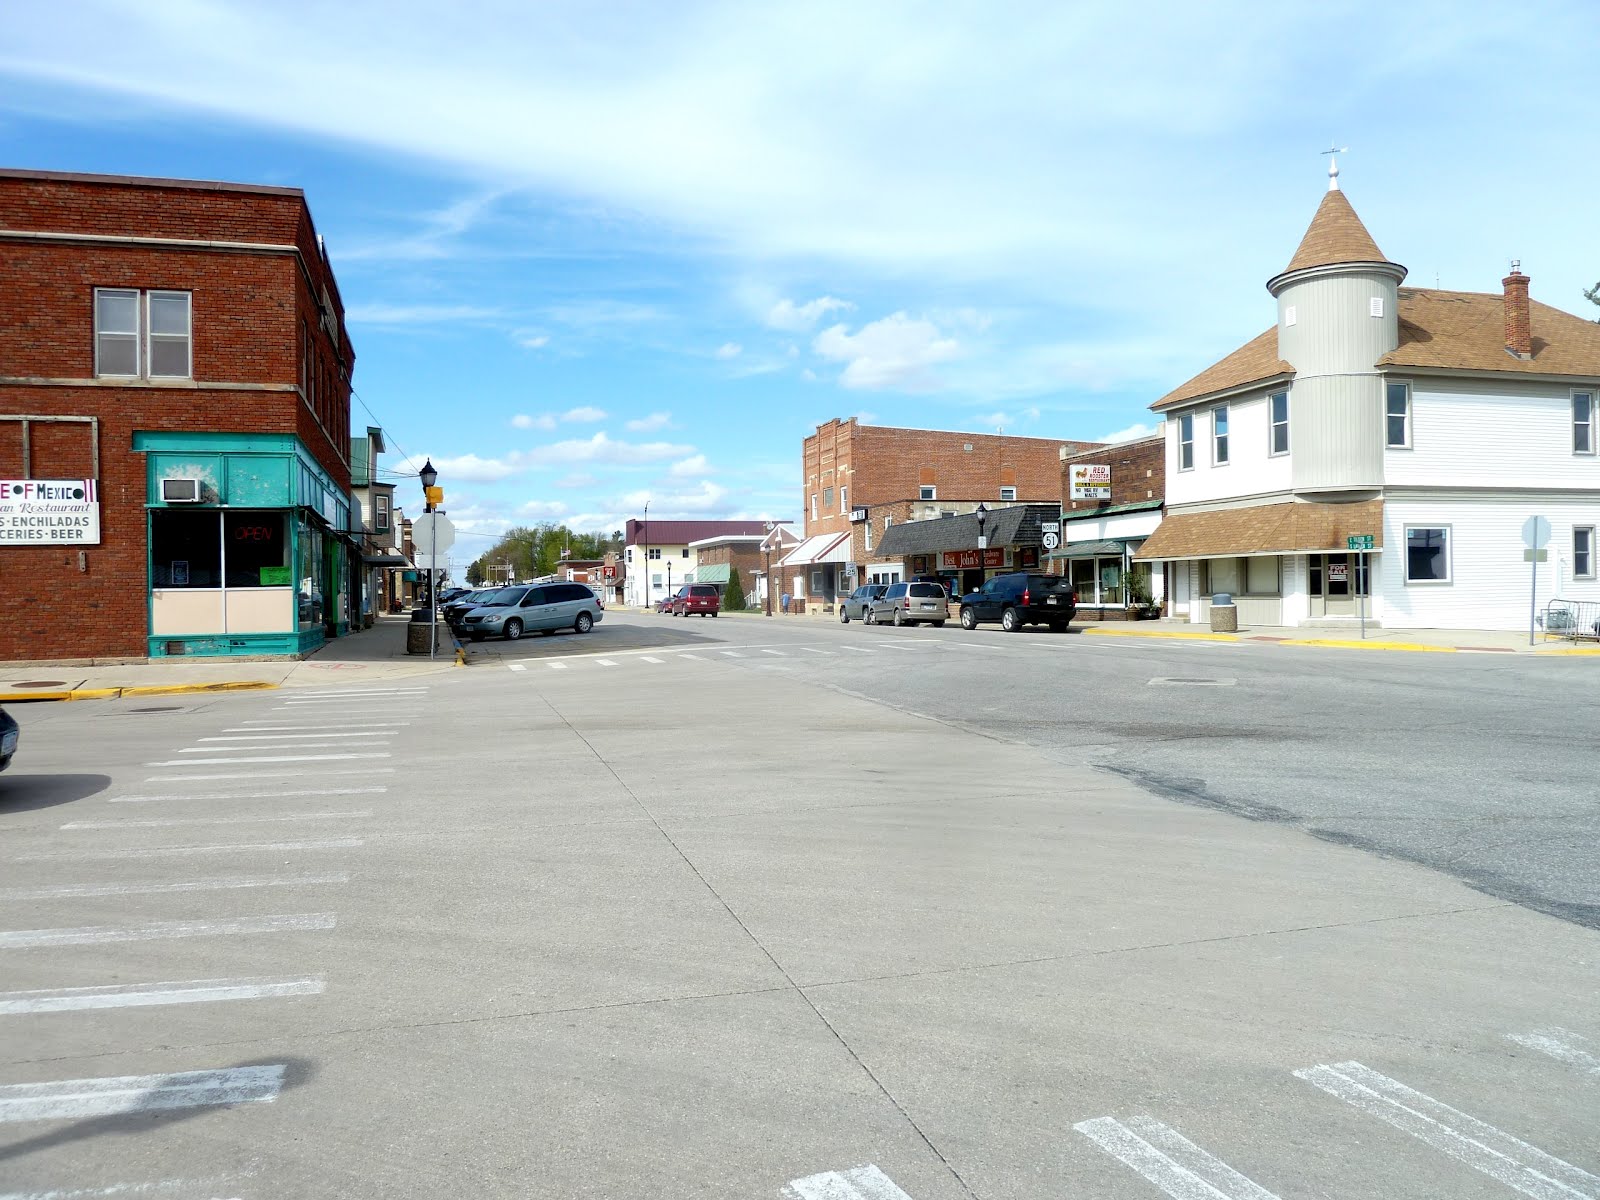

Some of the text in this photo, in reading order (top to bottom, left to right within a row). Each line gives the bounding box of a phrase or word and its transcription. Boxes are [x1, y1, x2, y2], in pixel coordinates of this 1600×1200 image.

[19, 502, 91, 514] Restaurant
[12, 516, 90, 527] ENCHILADAS
[50, 529, 84, 539] BEER
[234, 526, 273, 541] OPEN
[1046, 535, 1055, 546] 51
[960, 553, 978, 568] John's
